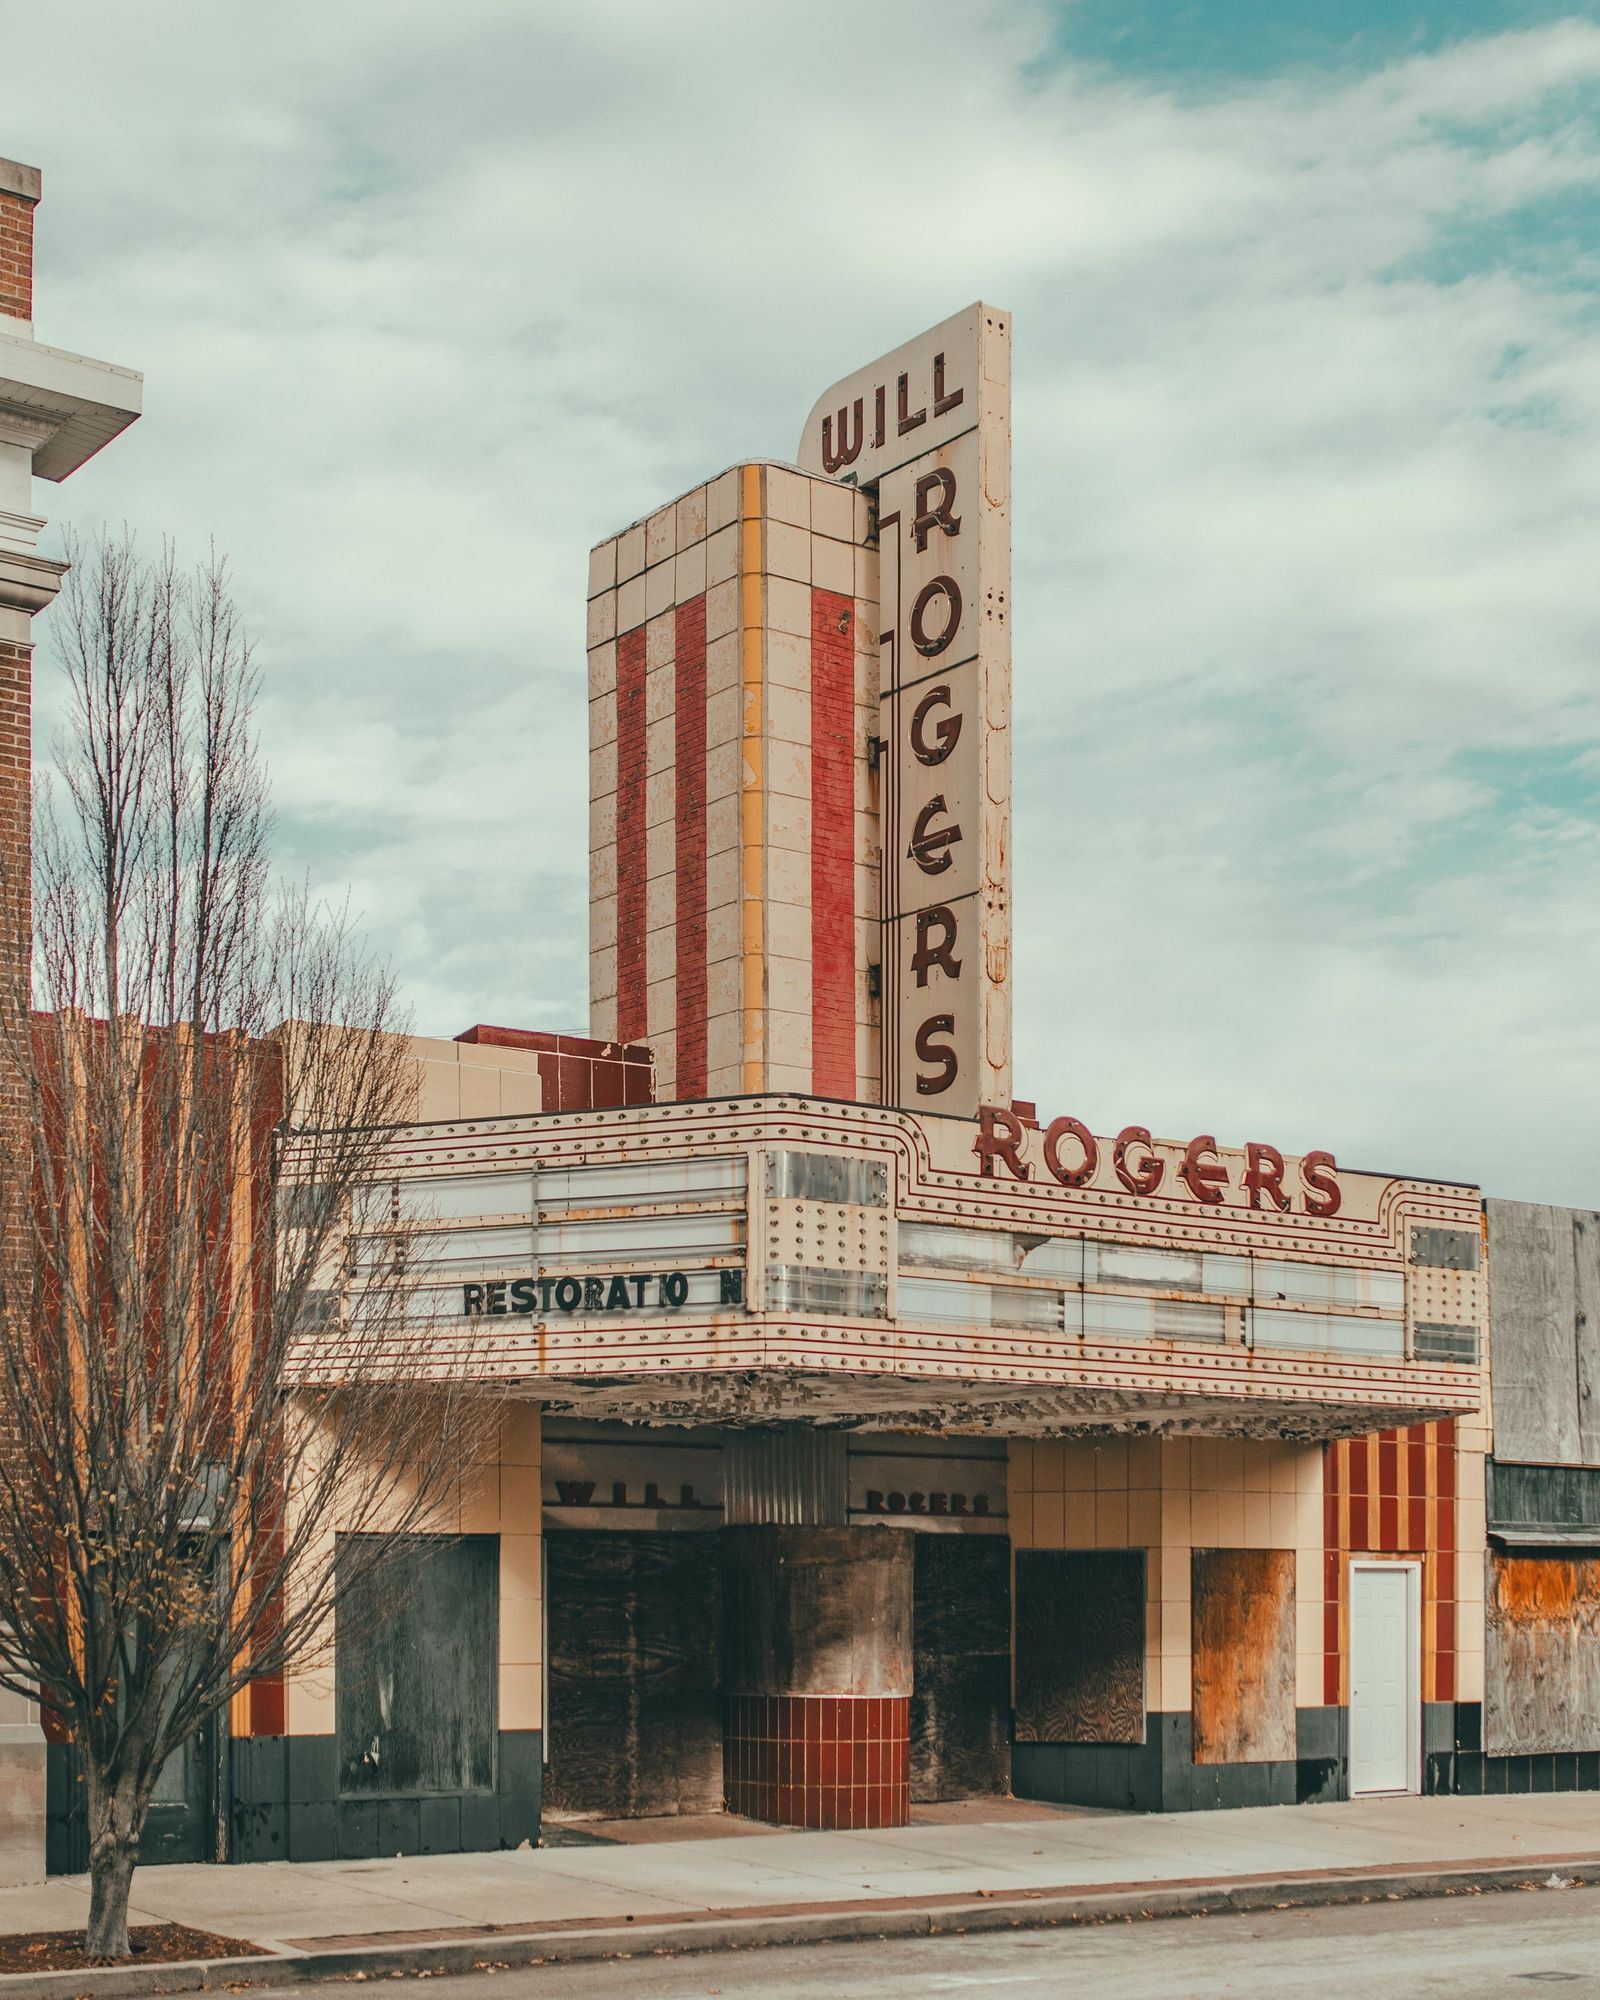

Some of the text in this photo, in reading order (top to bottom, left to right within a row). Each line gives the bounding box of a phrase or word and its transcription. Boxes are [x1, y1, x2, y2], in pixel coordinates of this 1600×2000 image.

[822, 352, 964, 474] WILL
[906, 466, 964, 1096] ROGERS
[972, 1105, 1342, 1217] ROGERS
[555, 1480, 990, 1516] WILL ROGERS
